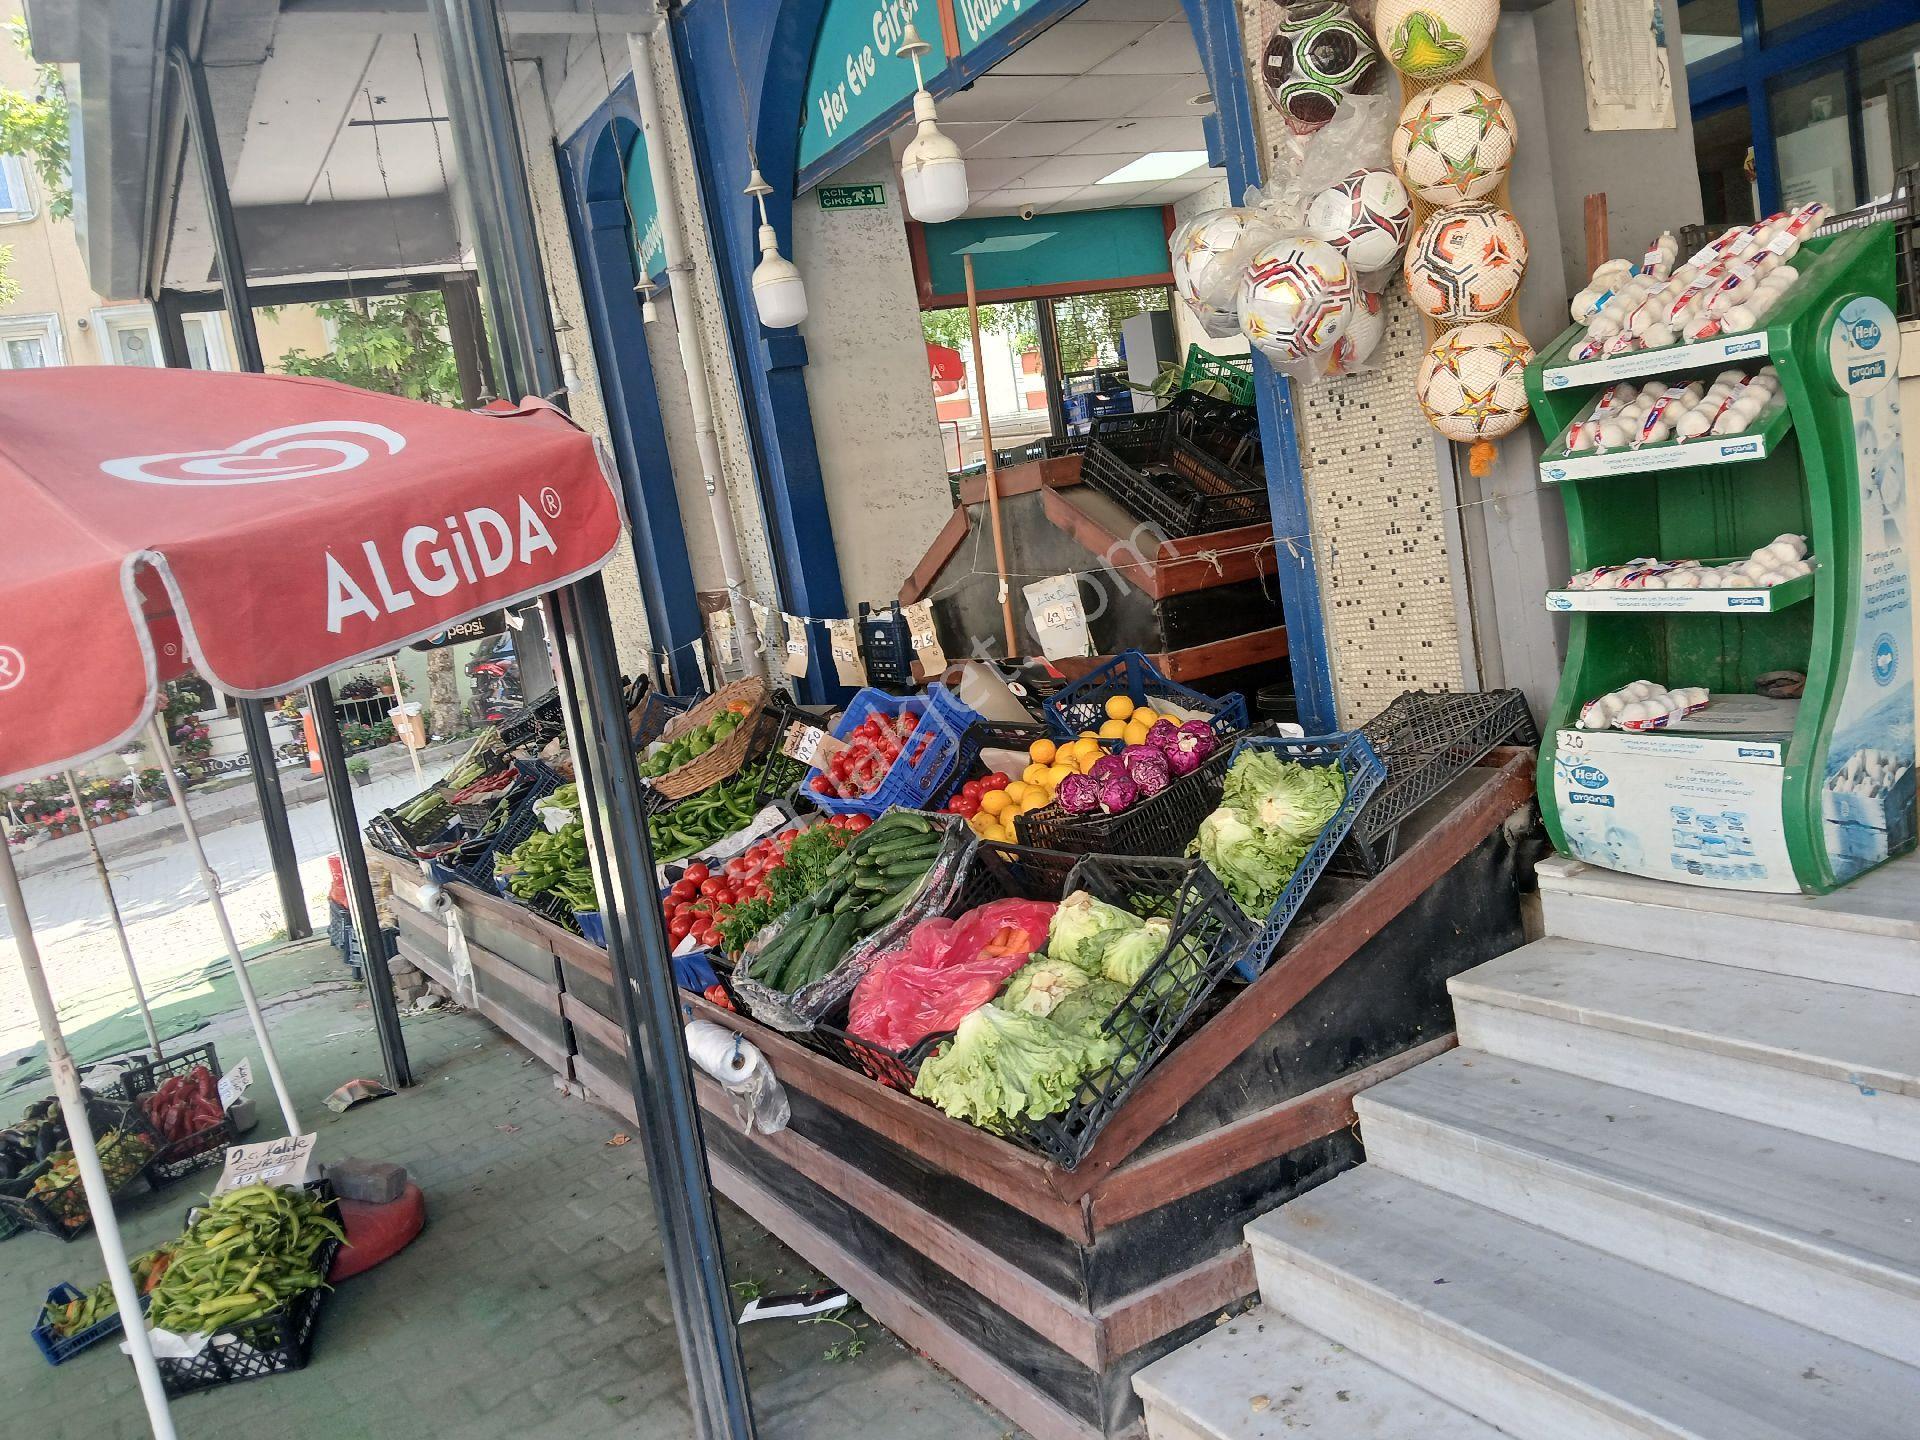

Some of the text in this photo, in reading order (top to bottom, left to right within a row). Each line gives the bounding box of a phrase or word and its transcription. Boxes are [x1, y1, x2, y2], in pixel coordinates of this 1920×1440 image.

[818, 81, 848, 138] Her
[846, 44, 876, 96] Eve
[1855, 323, 1879, 340] Hero
[1851, 362, 1883, 379] organik
[447, 617, 486, 640] pepsi
[1574, 768, 1606, 782] Hero
[1572, 793, 1612, 806] organik
